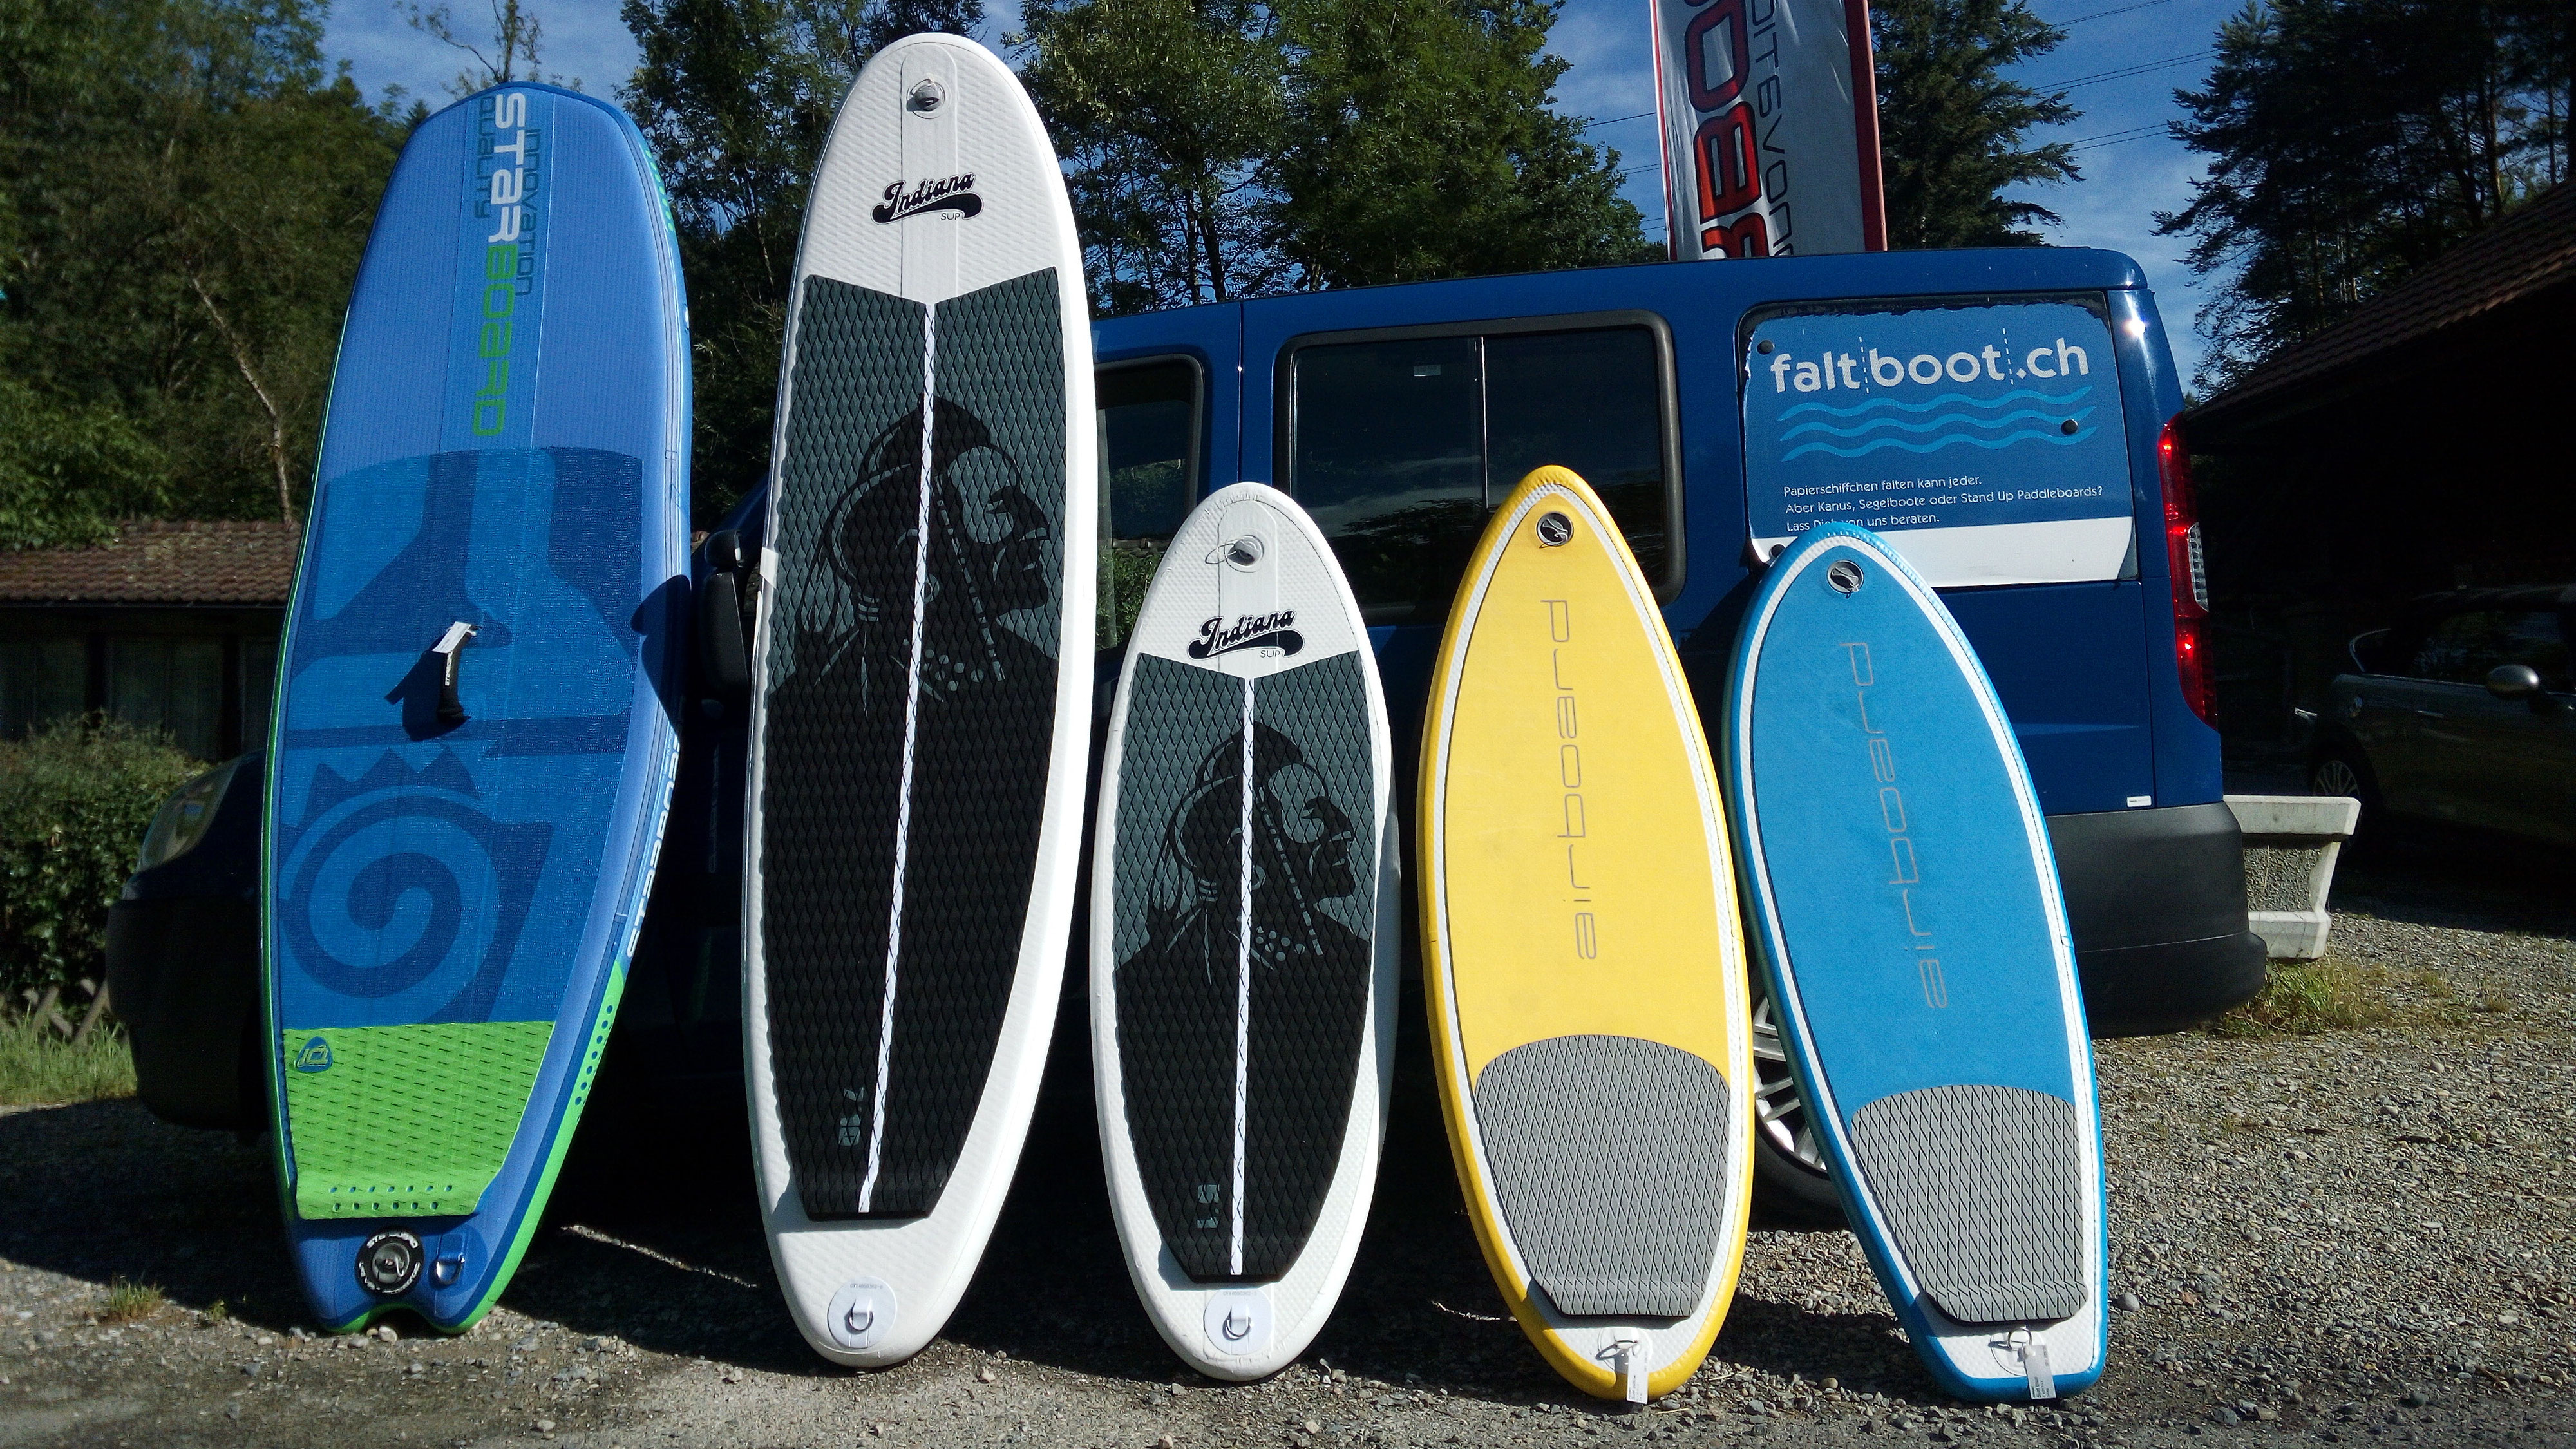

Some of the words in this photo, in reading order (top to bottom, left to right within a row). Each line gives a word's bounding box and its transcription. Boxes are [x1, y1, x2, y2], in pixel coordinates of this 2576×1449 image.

[882, 171, 977, 217] Indiana
[940, 212, 961, 220] SUP
[1784, 482, 1879, 498] Papierschiffchen
[1881, 478, 1914, 491] falten
[1917, 478, 1946, 488] kann
[1948, 475, 1982, 488] jeder.
[1785, 504, 1814, 514] Aber
[1817, 501, 1855, 512] Kanus,
[1859, 497, 1926, 510] Segelboote
[1929, 494, 1958, 505] oder
[1960, 491, 1994, 504] Stand
[1998, 491, 2014, 503] Up
[2017, 486, 2103, 500] Paddleboards?
[1786, 522, 1810, 532] Lass
[1841, 518, 1863, 527] on
[1867, 516, 1888, 526] uns
[1890, 513, 1940, 526] beraten.
[1198, 609, 1298, 656] Indiana
[1260, 649, 1280, 658] SUP
[1540, 600, 1597, 960] airboard
[1839, 642, 1948, 1008] airboard
